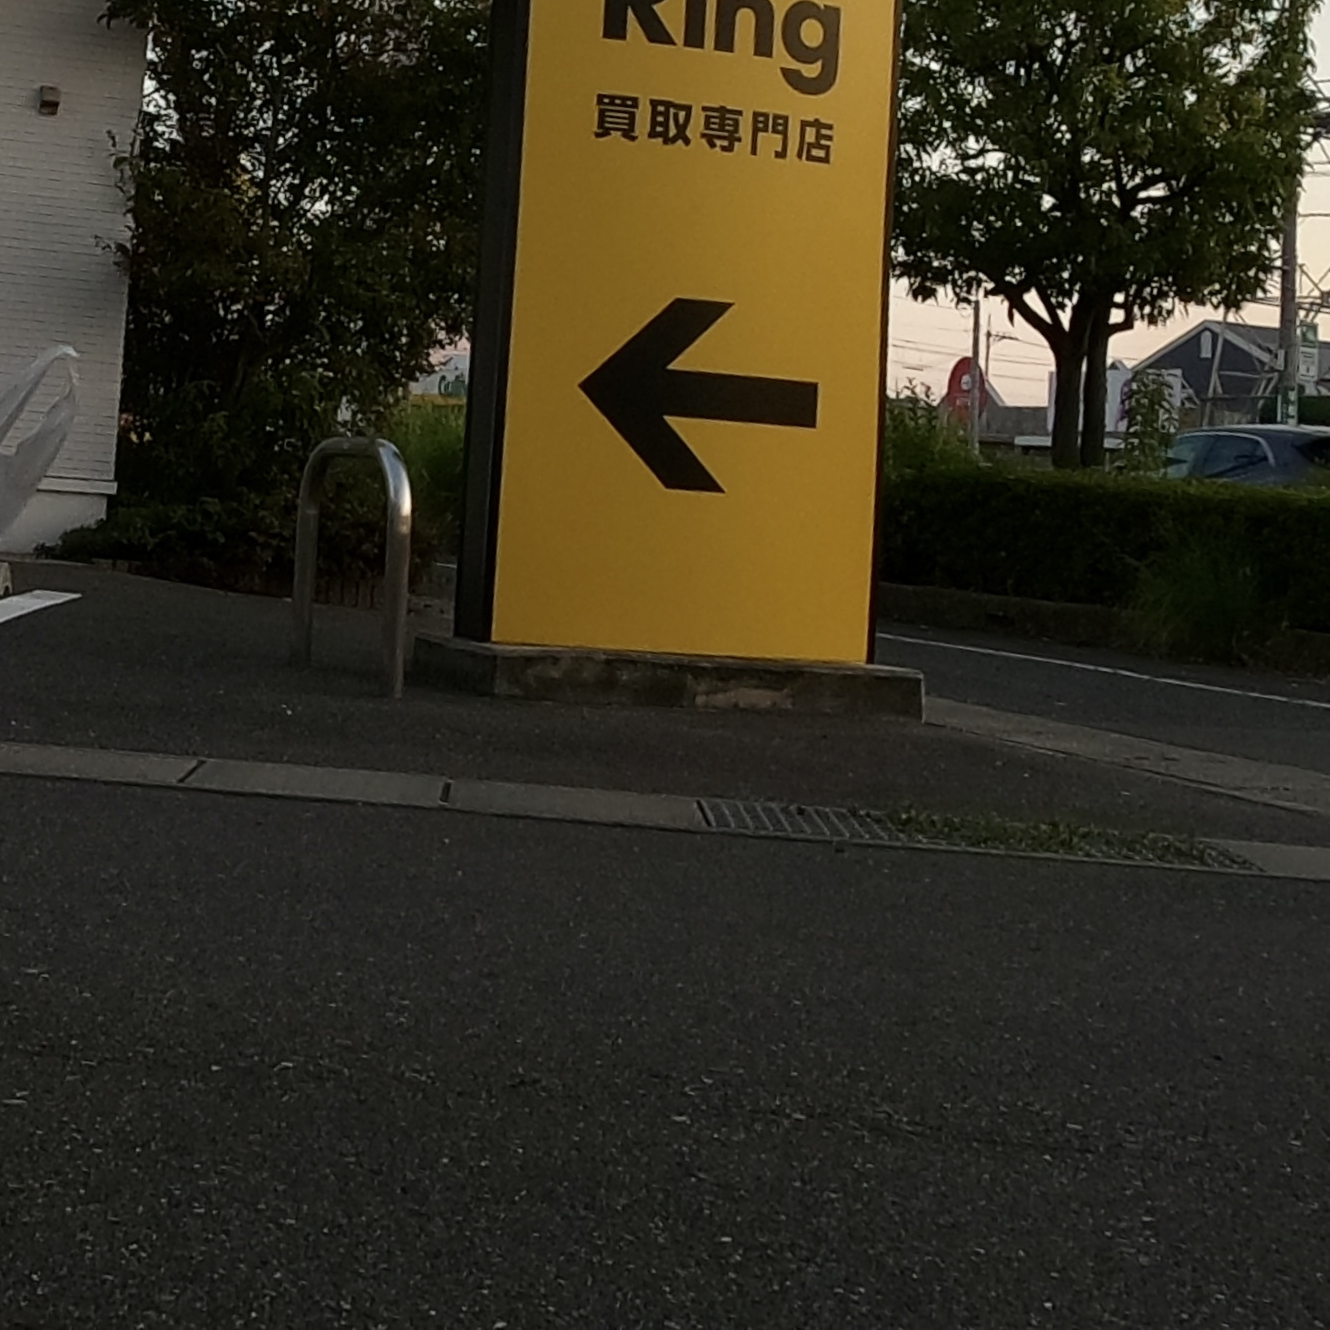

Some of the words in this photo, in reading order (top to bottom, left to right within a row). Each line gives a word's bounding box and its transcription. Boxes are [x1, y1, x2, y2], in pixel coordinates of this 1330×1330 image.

[593, 92, 835, 165] 買取専門店
